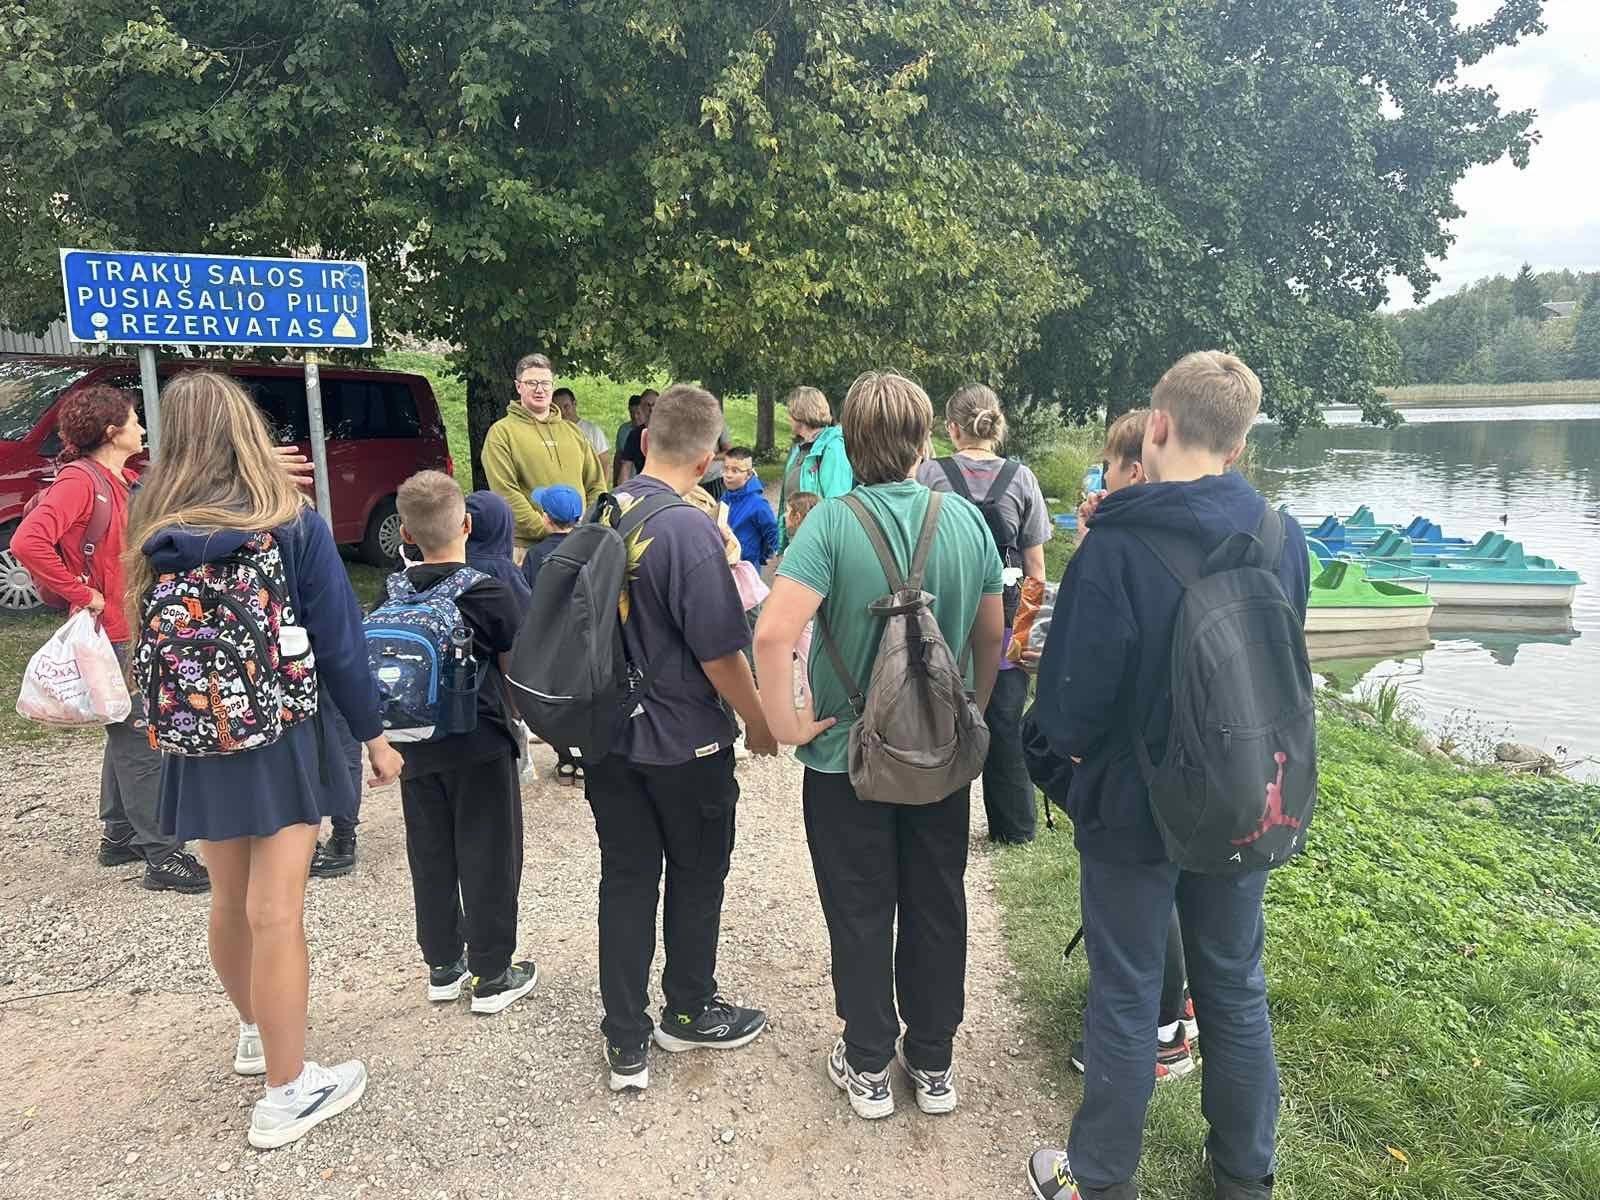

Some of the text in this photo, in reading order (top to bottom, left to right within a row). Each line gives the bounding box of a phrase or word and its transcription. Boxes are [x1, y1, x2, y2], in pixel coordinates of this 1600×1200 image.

[86, 260, 346, 289] TRAKŲ SALOS IR
[77, 286, 358, 319] PUSIAŠALIO PILIŲ
[122, 314, 324, 338] REZERVATAS
